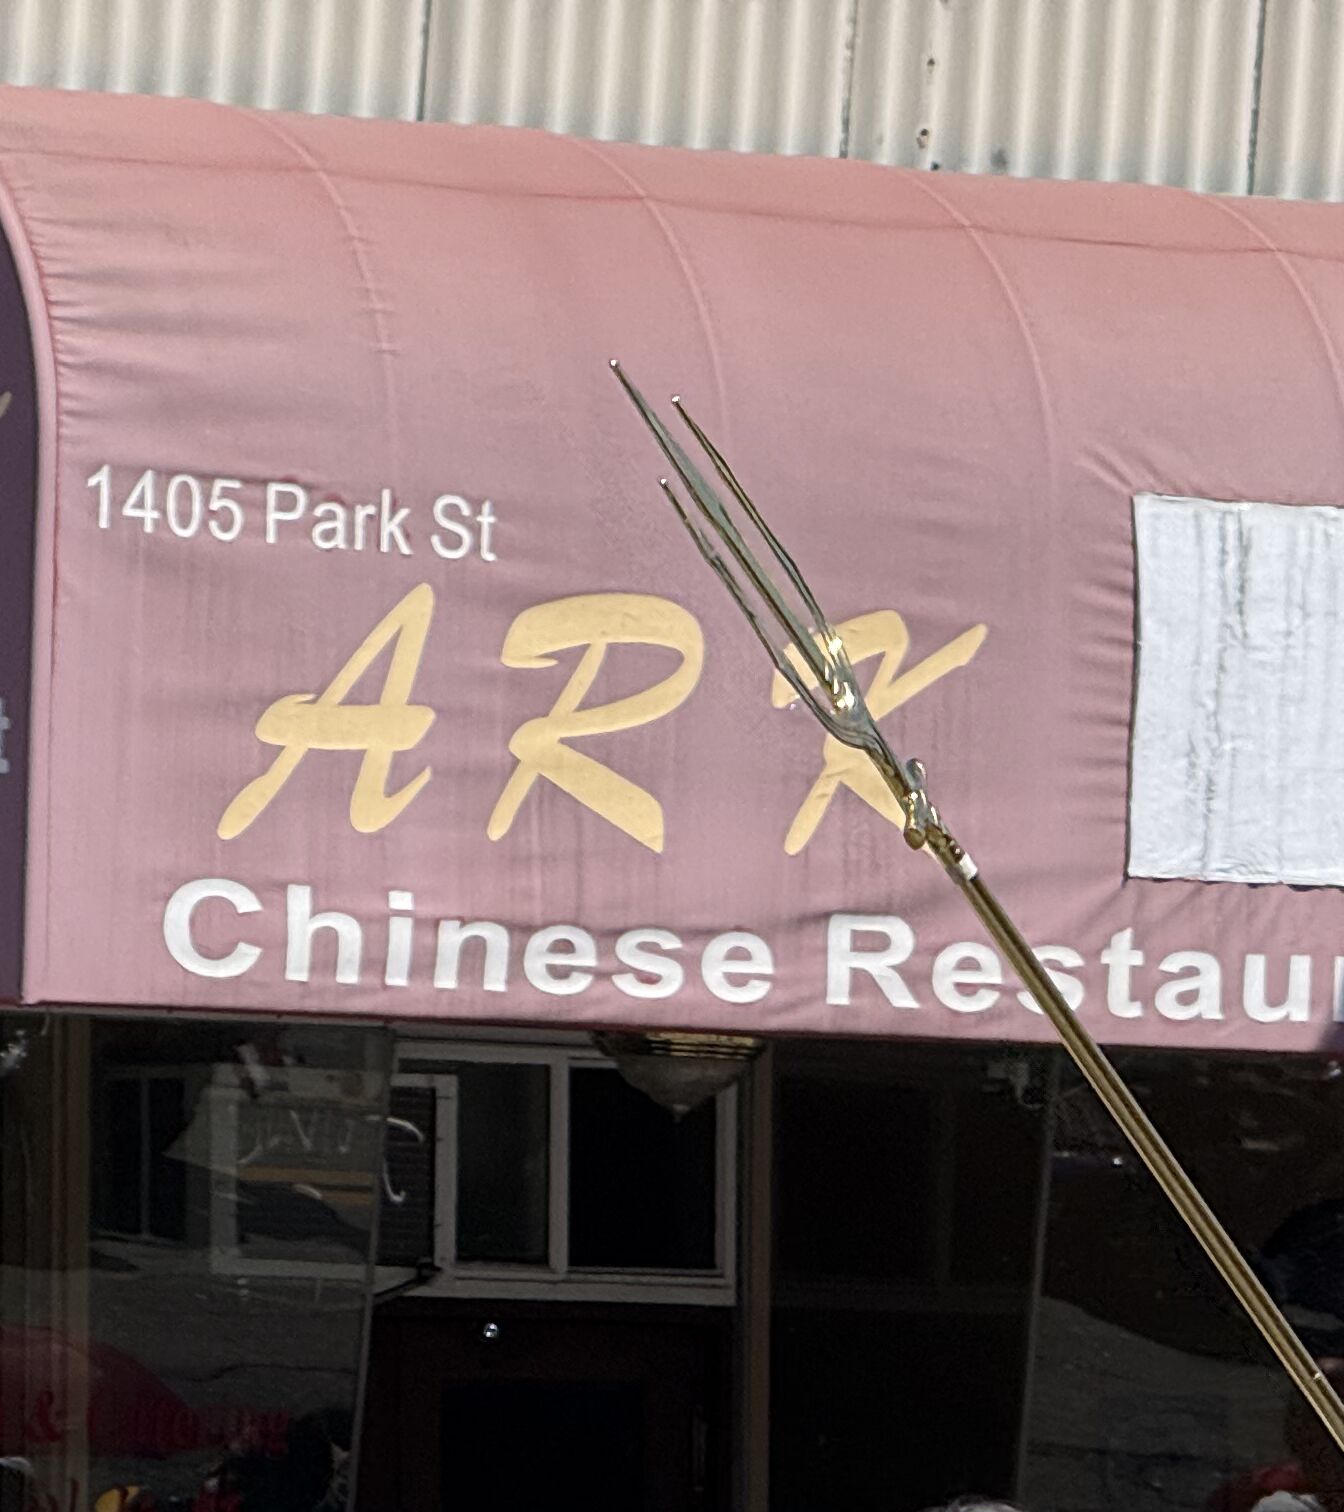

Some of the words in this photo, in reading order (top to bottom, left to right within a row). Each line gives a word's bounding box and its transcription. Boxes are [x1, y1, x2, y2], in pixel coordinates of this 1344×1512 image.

[87, 463, 245, 542] 1405
[265, 482, 413, 556] Park
[429, 494, 498, 562] St
[217, 581, 988, 856] ARK
[163, 876, 775, 1003] Chinese
